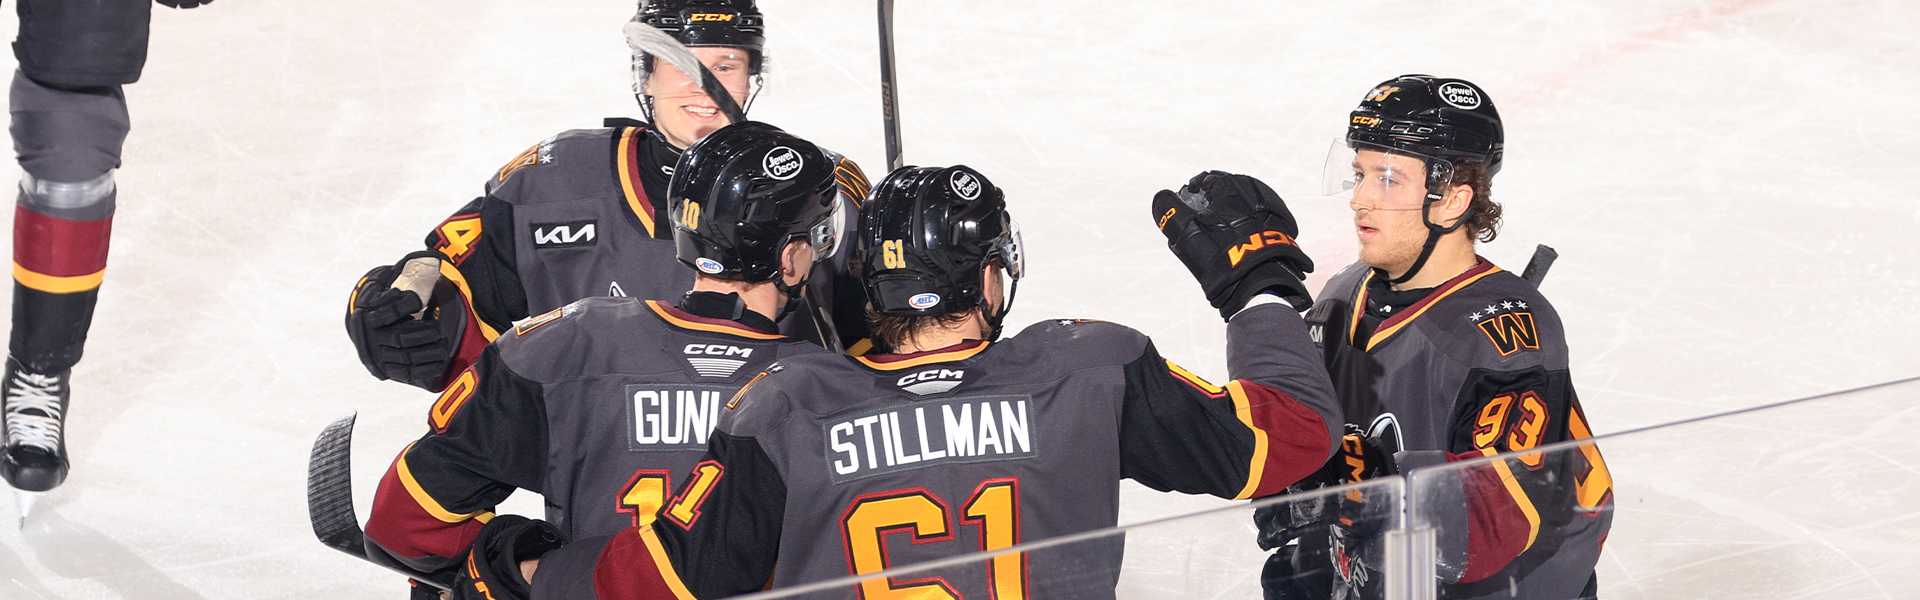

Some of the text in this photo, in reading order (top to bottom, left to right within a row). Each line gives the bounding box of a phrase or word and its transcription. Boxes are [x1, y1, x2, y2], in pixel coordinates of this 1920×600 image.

[690, 13, 733, 21] CCM
[1445, 86, 1473, 96] Jewel
[1353, 116, 1380, 125] CCM
[769, 150, 794, 168] Jewel
[681, 198, 699, 230] 10
[433, 212, 483, 267] 4
[883, 239, 906, 269] 61
[683, 343, 753, 358] CCM
[1476, 311, 1541, 358] W
[896, 369, 964, 386] CCM
[428, 365, 480, 435] 0
[830, 400, 1031, 475] STILLMAN
[1472, 390, 1550, 471] 93
[662, 459, 725, 532] 1
[838, 476, 1030, 600] 61
